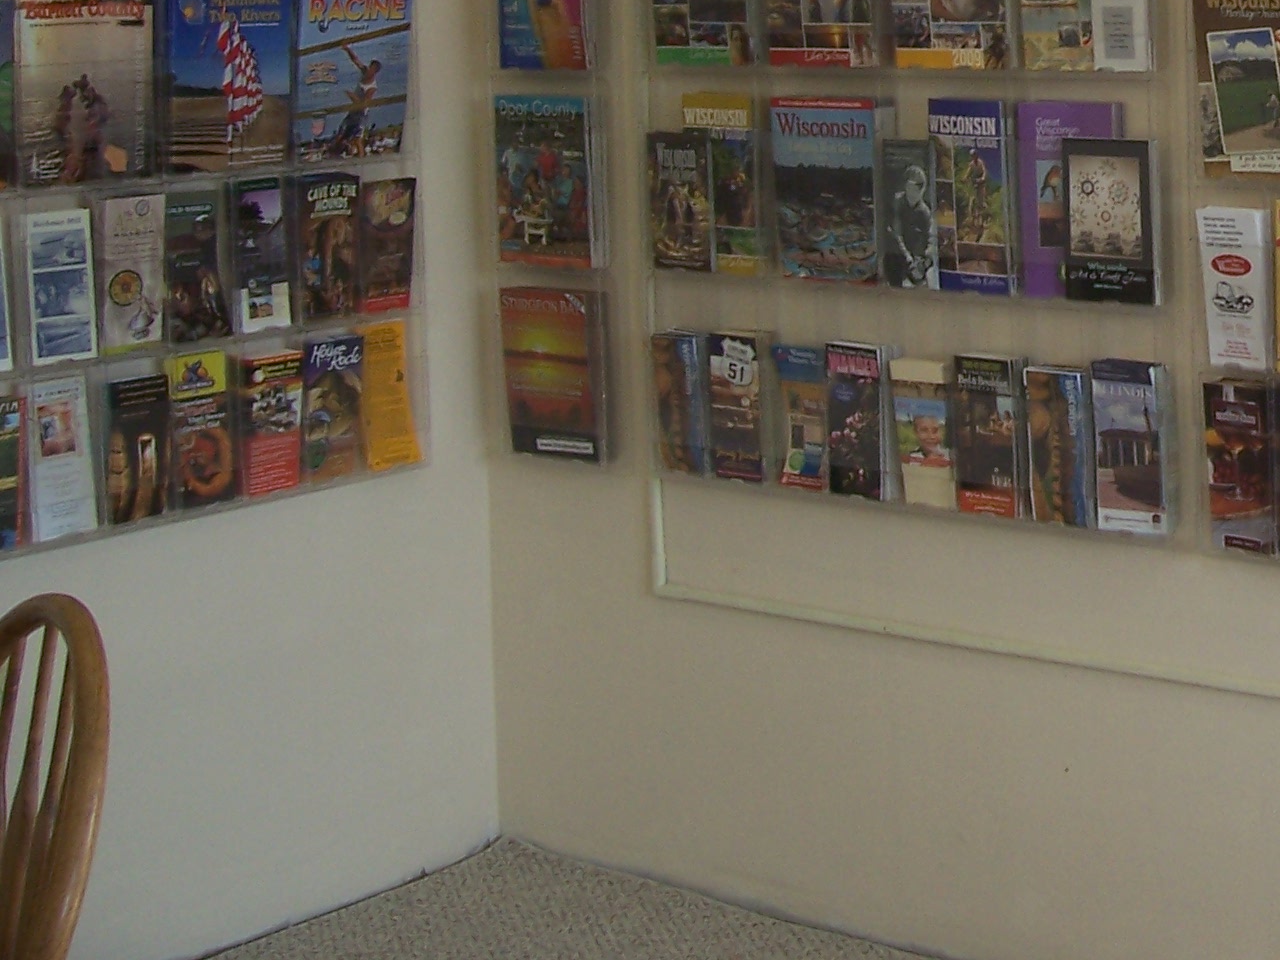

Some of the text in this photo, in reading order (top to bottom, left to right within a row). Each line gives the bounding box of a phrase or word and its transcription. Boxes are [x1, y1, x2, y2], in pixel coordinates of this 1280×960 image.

[209, 7, 283, 23] Two Rivers
[952, 49, 983, 67] 2009
[499, 98, 579, 121] Door County
[682, 107, 748, 127] WISCONSIN
[776, 111, 868, 139] Wisconsin
[929, 113, 997, 136] WISCONSIN
[307, 183, 358, 203] CAVE OF THE
[313, 196, 349, 212] MOUNDS
[328, 346, 363, 371] Rock
[728, 363, 745, 383] 51
